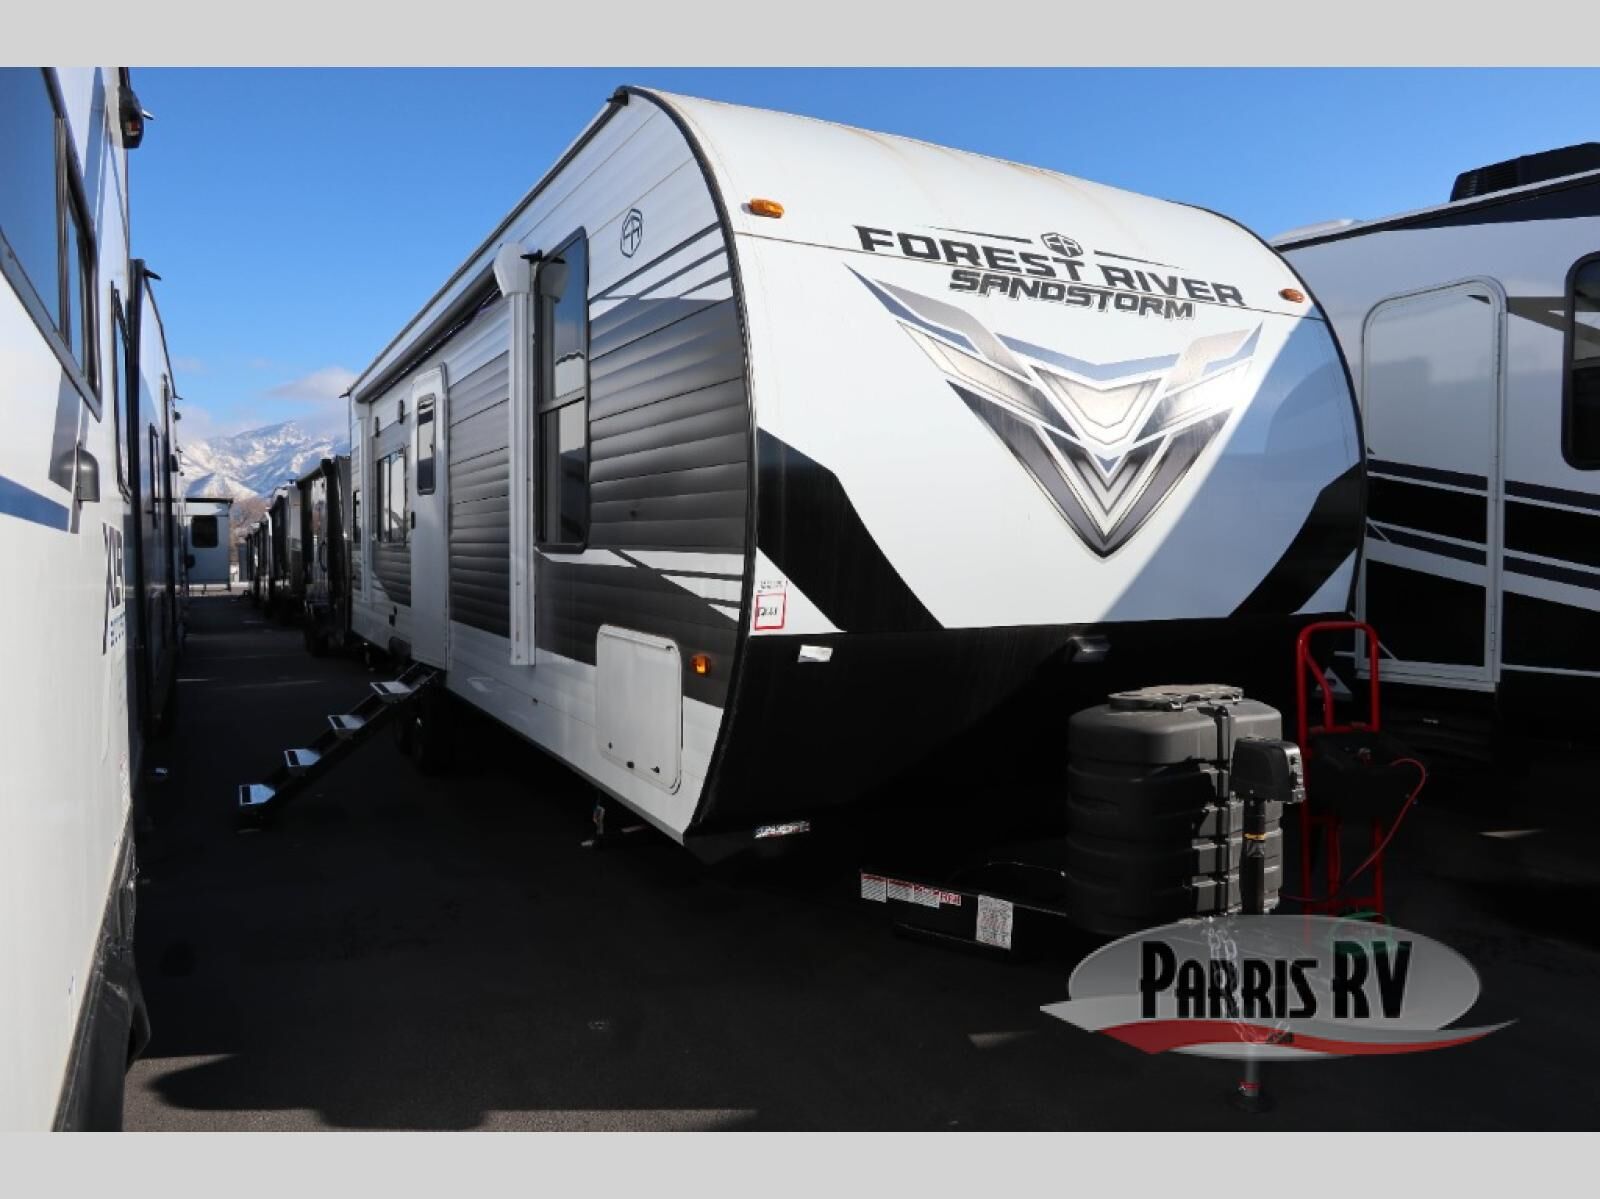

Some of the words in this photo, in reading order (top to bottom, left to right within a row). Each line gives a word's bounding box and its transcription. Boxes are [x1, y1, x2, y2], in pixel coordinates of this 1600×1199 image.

[852, 225, 1086, 281] FOREST
[1096, 263, 1247, 307] RIVER
[949, 268, 1195, 320] SANDSTORM
